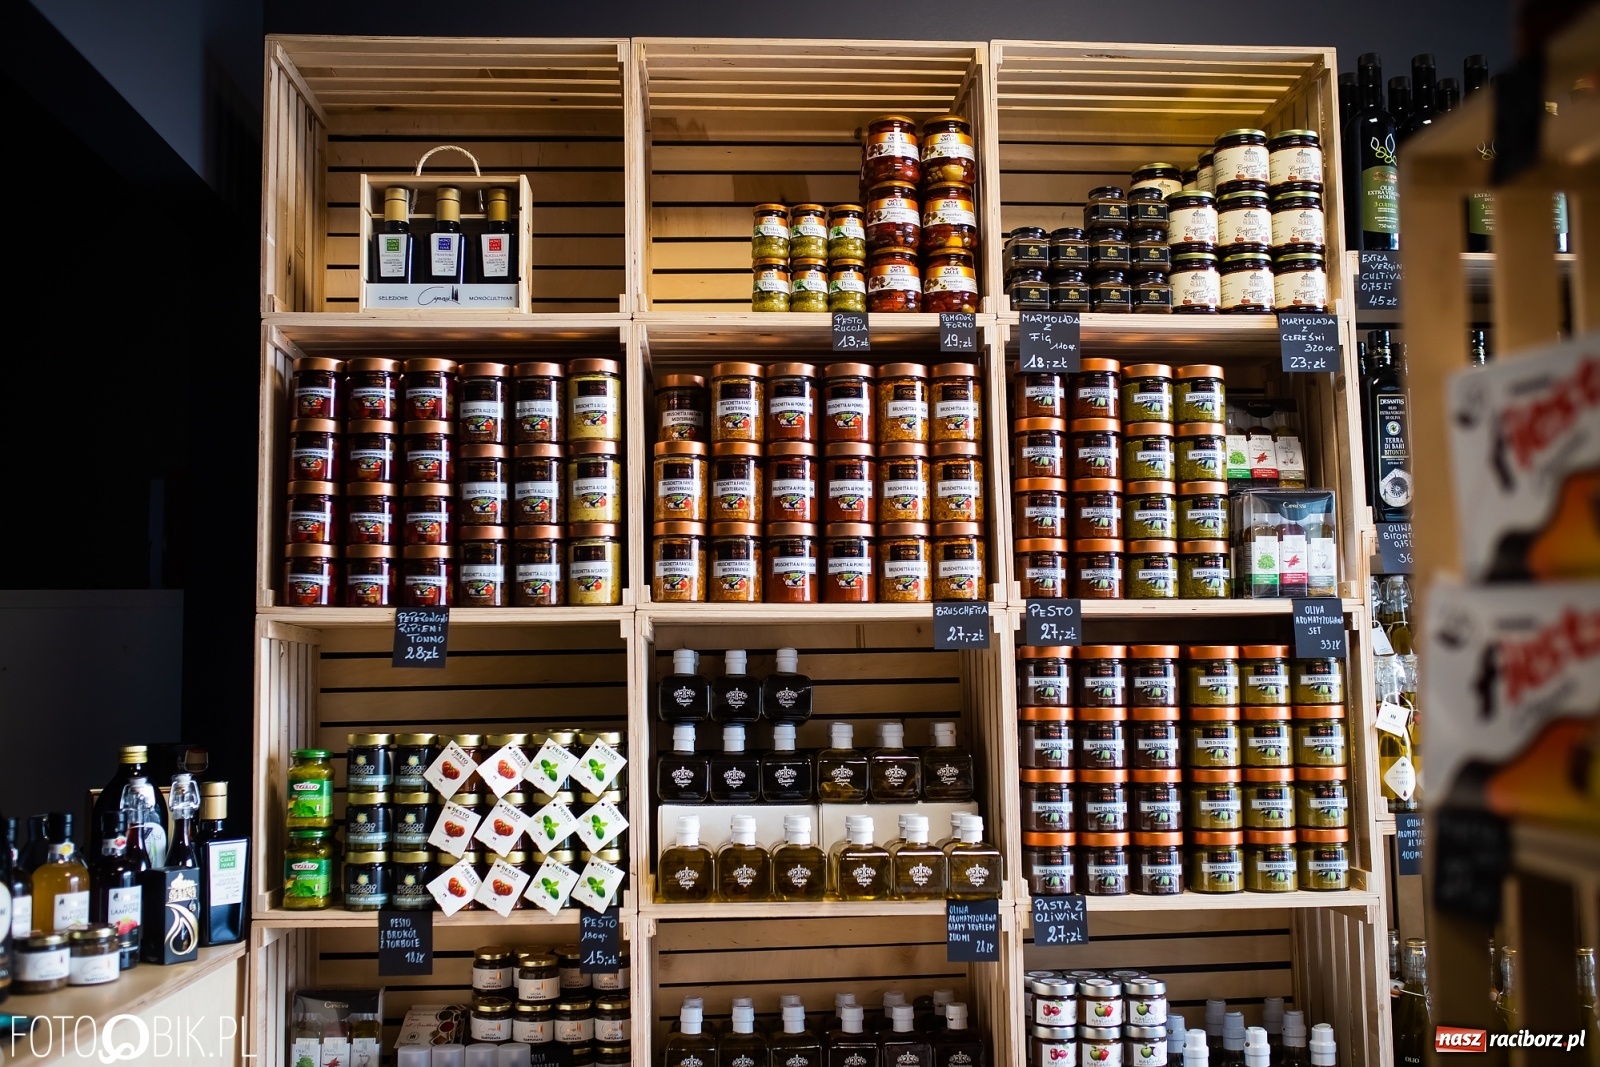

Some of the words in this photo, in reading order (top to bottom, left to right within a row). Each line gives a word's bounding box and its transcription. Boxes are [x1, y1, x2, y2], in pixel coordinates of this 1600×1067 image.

[1362, 254, 1388, 263] EXTRA
[1369, 295, 1386, 306] 45
[834, 314, 862, 325] PESTO
[1022, 314, 1080, 324] MARMOLADA
[936, 605, 988, 616] BRUSCHETTA
[1028, 603, 1073, 617] PESTO
[398, 623, 441, 633] RIPIENI
[1308, 626, 1322, 635] SET
[406, 633, 444, 644] TONNO
[453, 749, 469, 765] PESTO
[513, 750, 527, 767] PESTO
[552, 746, 569, 761] PESTO
[601, 746, 618, 761] PESTO
[452, 804, 470, 817] PESTO
[502, 804, 521, 818] PESTO
[558, 802, 572, 820] PESTO
[606, 800, 621, 818] PESTO
[501, 866, 519, 879] PESTO
[552, 863, 569, 877] PESTO
[596, 862, 614, 875] PESTO
[463, 868, 478, 885] PESTO
[1035, 898, 1071, 911] PASTA
[1075, 900, 1083, 911] Z
[390, 918, 411, 927] PESTO
[582, 916, 618, 928] PESTO
[386, 938, 420, 949] TORBOLE
[1404, 1056, 1420, 1064] OLIO
